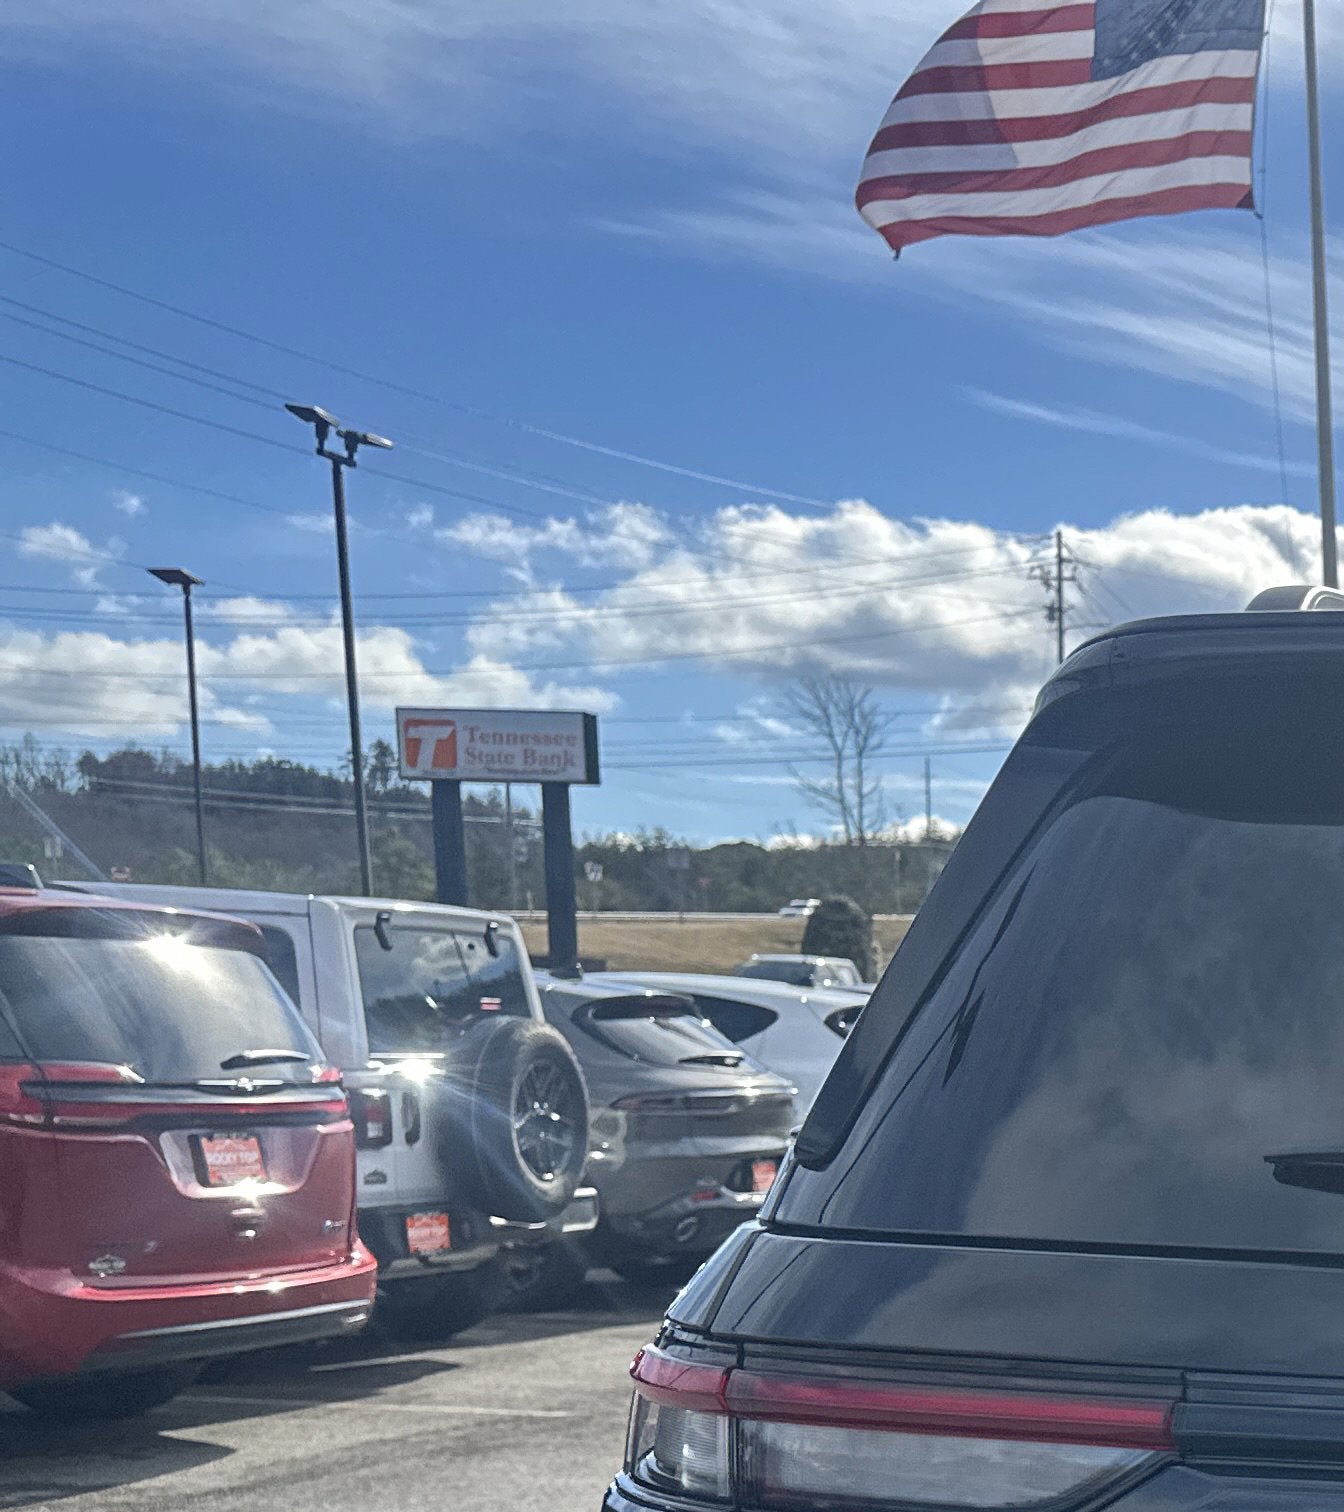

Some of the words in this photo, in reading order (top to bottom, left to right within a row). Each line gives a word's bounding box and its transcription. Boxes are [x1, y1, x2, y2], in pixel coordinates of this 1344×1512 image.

[463, 726, 578, 747] Tennessee
[465, 749, 515, 767] State
[522, 749, 577, 769] Bank
